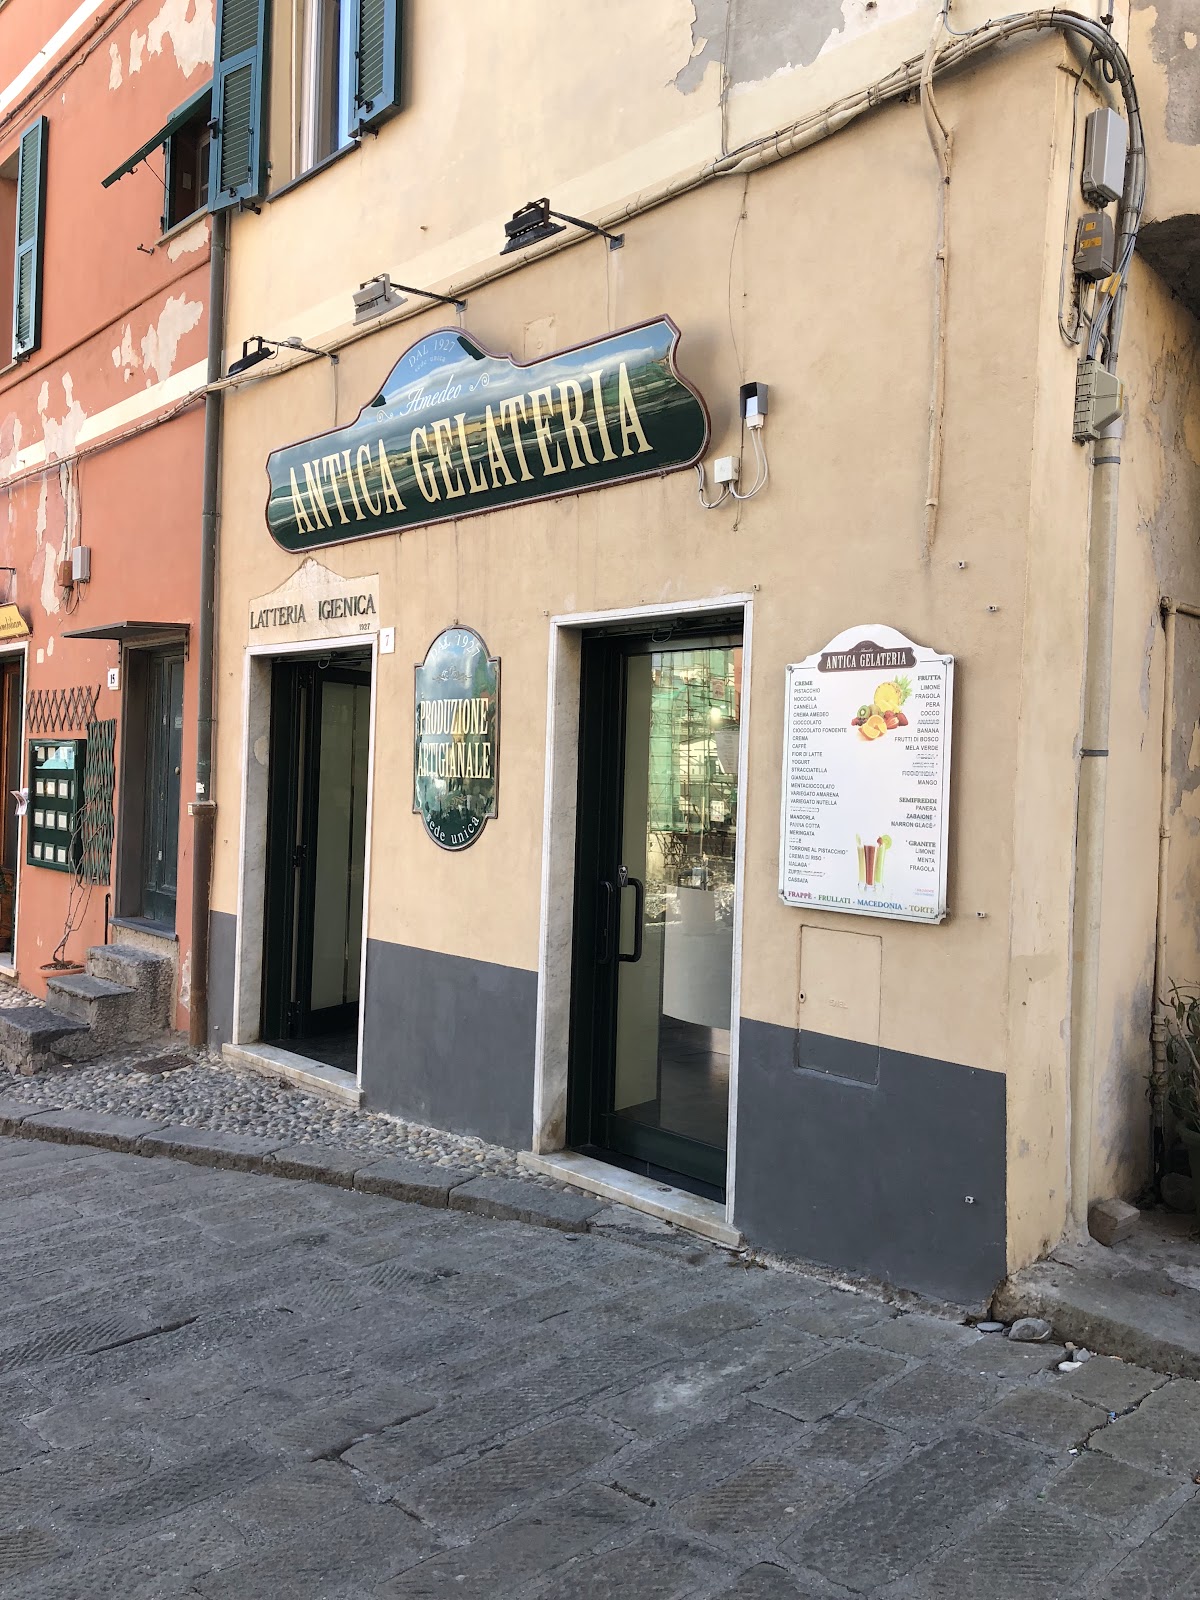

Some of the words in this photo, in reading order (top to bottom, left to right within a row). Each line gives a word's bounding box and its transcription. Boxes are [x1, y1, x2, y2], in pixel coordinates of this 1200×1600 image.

[408, 345, 429, 368] DAL
[434, 339, 456, 353] 1927
[400, 373, 462, 416] Amedeo
[290, 439, 407, 535] ANTICA
[411, 361, 654, 503] GELATERIA
[249, 603, 307, 629] LATTERIA
[318, 593, 376, 621] IGIENICA
[359, 622, 371, 631] 1927
[385, 634, 390, 647] 7
[456, 634, 481, 657] 1927
[826, 654, 856, 669] ANTICA
[860, 651, 907, 667] GELATERIA
[110, 673, 116, 684] 15
[419, 698, 489, 735] PRODUZIONE
[418, 742, 491, 779] ARTIGIANALE
[450, 816, 480, 844] unica
[788, 890, 812, 900] FRAPPÈ
[818, 894, 850, 904] FRULLATI
[857, 899, 902, 910] MACEDONIA
[908, 904, 935, 914] TORTE
